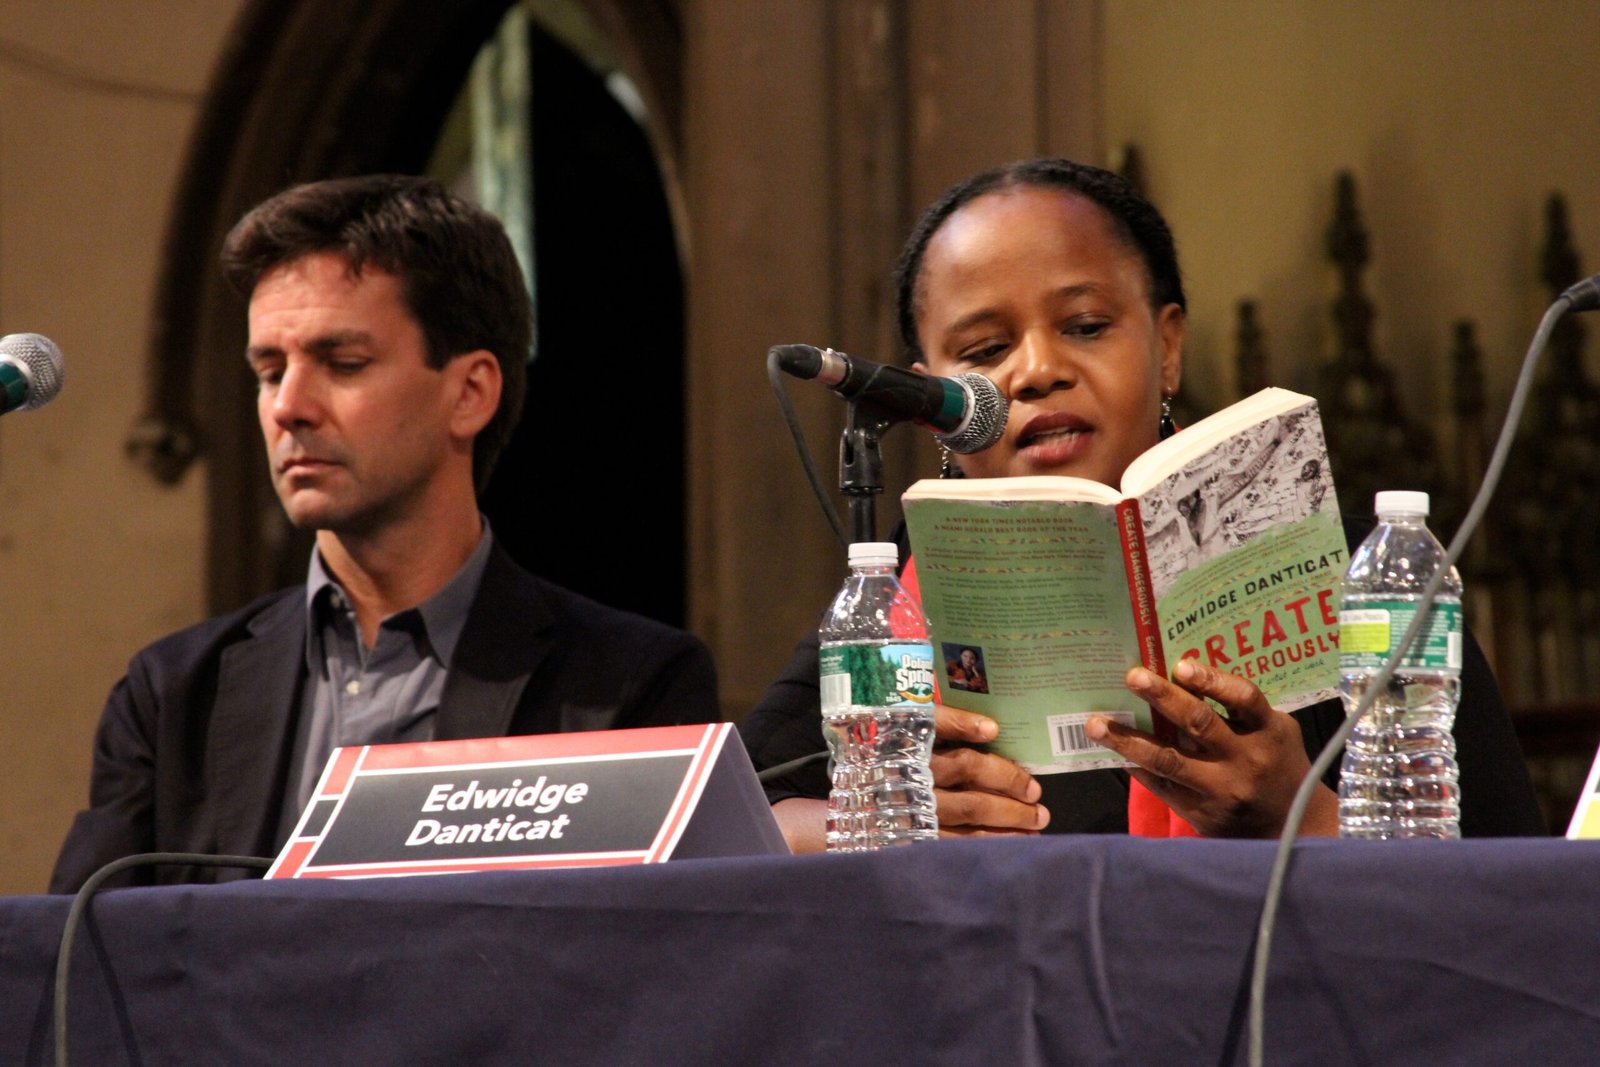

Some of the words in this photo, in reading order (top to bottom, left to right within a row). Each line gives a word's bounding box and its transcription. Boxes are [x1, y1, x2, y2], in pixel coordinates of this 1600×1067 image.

[1122, 507, 1139, 549] CREATE
[1130, 551, 1152, 627] DANGEROUSLY
[1168, 590, 1237, 640] EDWIDGE
[1244, 549, 1343, 596] DANTICAT
[1231, 630, 1340, 678] GEROUSLY
[421, 776, 589, 814] Edwidge
[404, 814, 570, 846] Danticat
